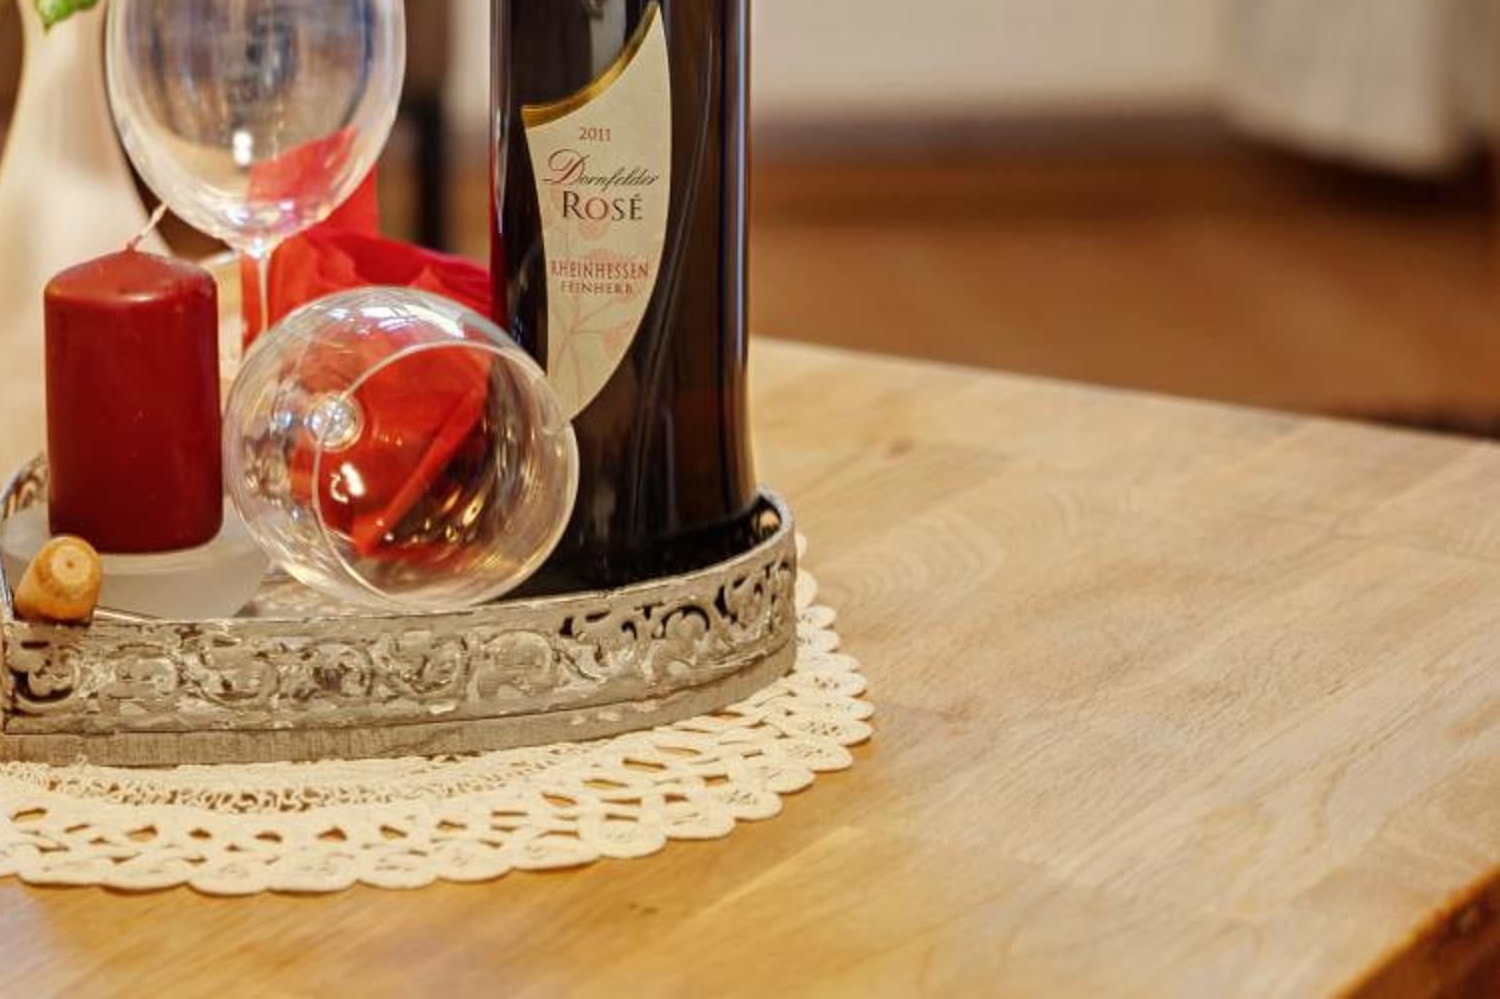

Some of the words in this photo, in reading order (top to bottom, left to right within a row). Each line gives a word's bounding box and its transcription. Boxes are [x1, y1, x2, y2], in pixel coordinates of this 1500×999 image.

[579, 127, 612, 142] 2011
[540, 148, 660, 191] Dornfelder
[563, 190, 643, 221] ROSÉ
[550, 259, 649, 280] RHEINHESSEN
